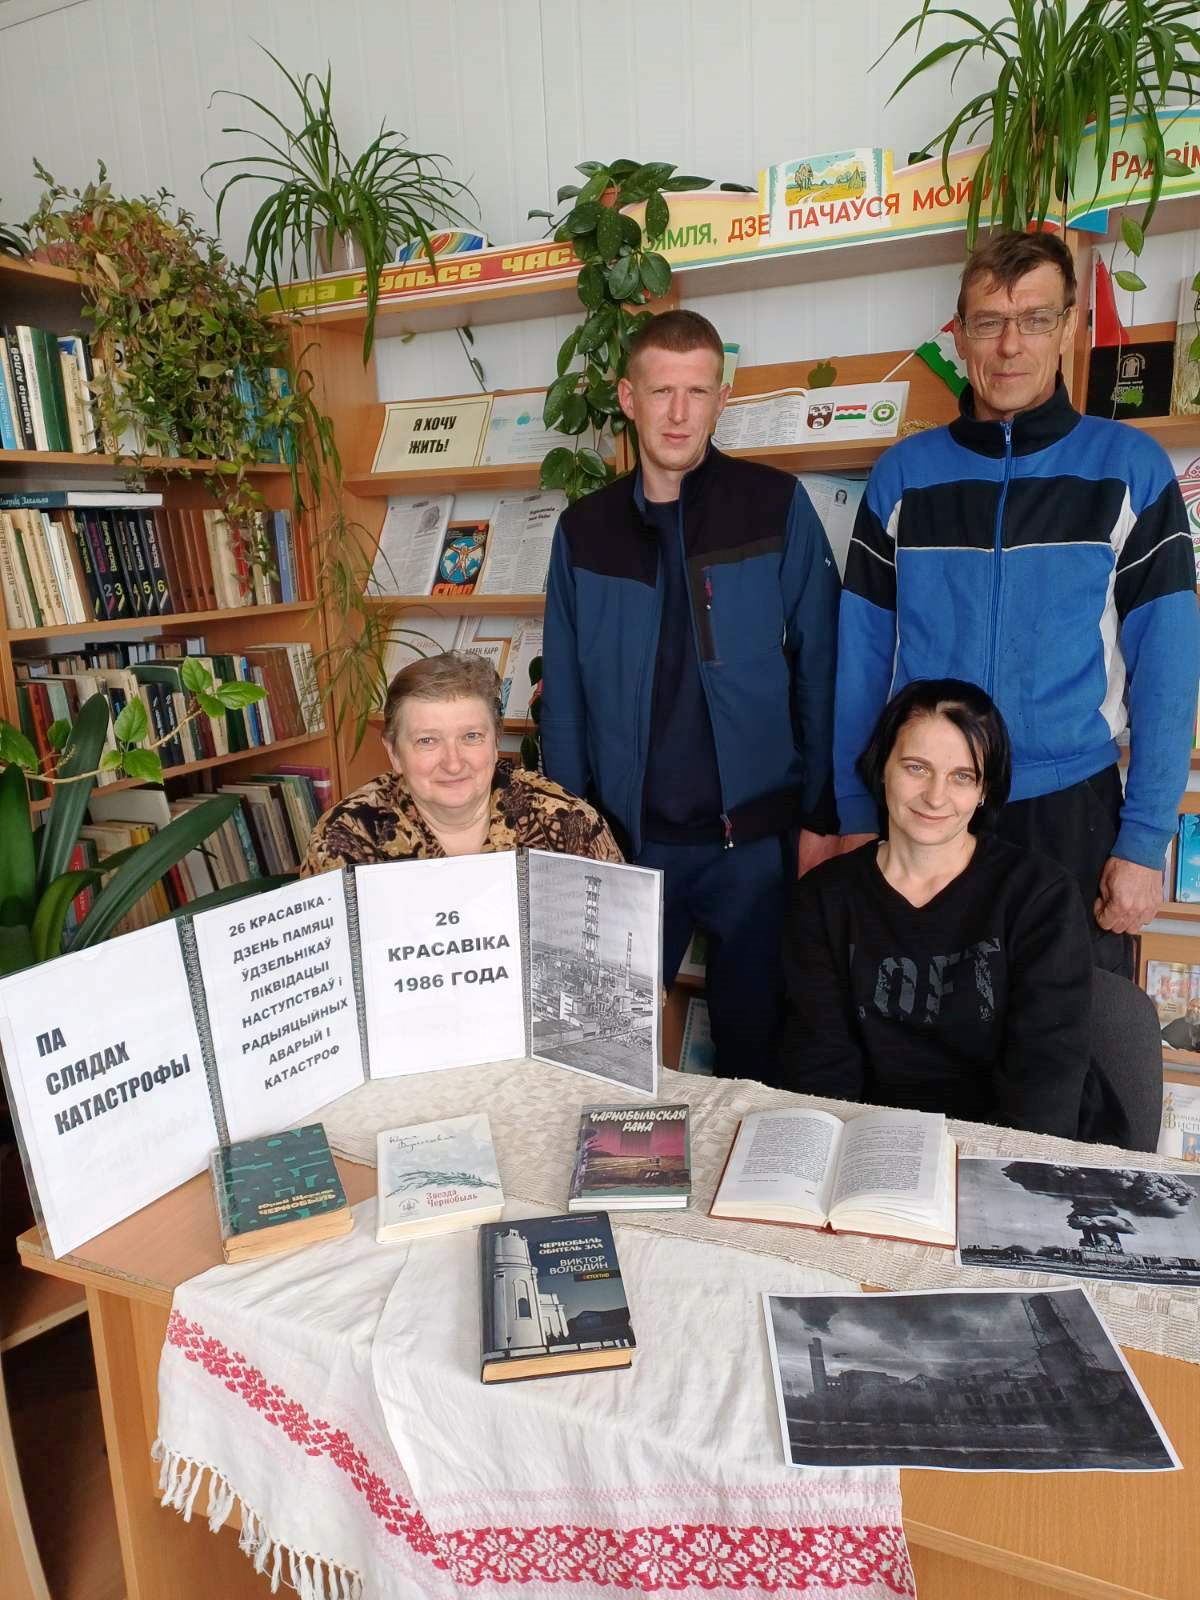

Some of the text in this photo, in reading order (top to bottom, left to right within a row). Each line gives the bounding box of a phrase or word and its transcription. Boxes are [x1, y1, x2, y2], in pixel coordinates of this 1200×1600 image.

[728, 214, 770, 243] ДЗЕ
[788, 192, 900, 230] ПАЧАЎСЯ
[913, 176, 974, 212] МОЙ
[297, 284, 336, 304] на
[502, 247, 580, 272] час
[413, 416, 458, 431] Я ХОЧУ
[408, 438, 450, 454] ЖИТЬ!
[104, 584, 113, 597] 2
[114, 583, 123, 596] 3
[143, 581, 151, 594] 5
[157, 580, 165, 593] 6
[229, 922, 246, 937] 26
[249, 896, 324, 930] КРАСАВІКА
[435, 910, 460, 927] 26
[233, 916, 334, 964] ДЗЕНЬ ПАМЯЦІ
[388, 934, 510, 962] КРАСАВІКА
[241, 936, 331, 982] ЎДЗЕЛЬНІКАЎ
[250, 961, 330, 1002] ЛІКВІДАЦЫІ
[394, 966, 509, 993] 1986 ГОДА
[242, 977, 335, 1028] НАСТУПСТВАЎ
[241, 998, 348, 1055] РАДЫЯЦЫЙНЫХ
[36, 1027, 67, 1057] ПА
[269, 1029, 323, 1065] АВАРЫЙ
[45, 1040, 131, 1096] СЛЯДАХ
[264, 1045, 340, 1090] КАТАСТРОФ
[54, 1053, 191, 1136] КАТАСТРОФЫ
[590, 1110, 687, 1122] ЧАРНОБЫЛЬСКАЯ
[622, 1121, 654, 1132] РАНА
[258, 1194, 336, 1215] ЧЕРНОБЫЛЬ
[426, 1189, 457, 1200] Звезда
[427, 1193, 478, 1208] Чернобыль
[539, 1237, 602, 1249] ЧЕРНОБЫЛЬ
[539, 1245, 582, 1255] ОБИТЕЛЬ
[549, 1261, 609, 1275] ВОЛОДИН
[560, 1255, 605, 1267] ВИКТОР
